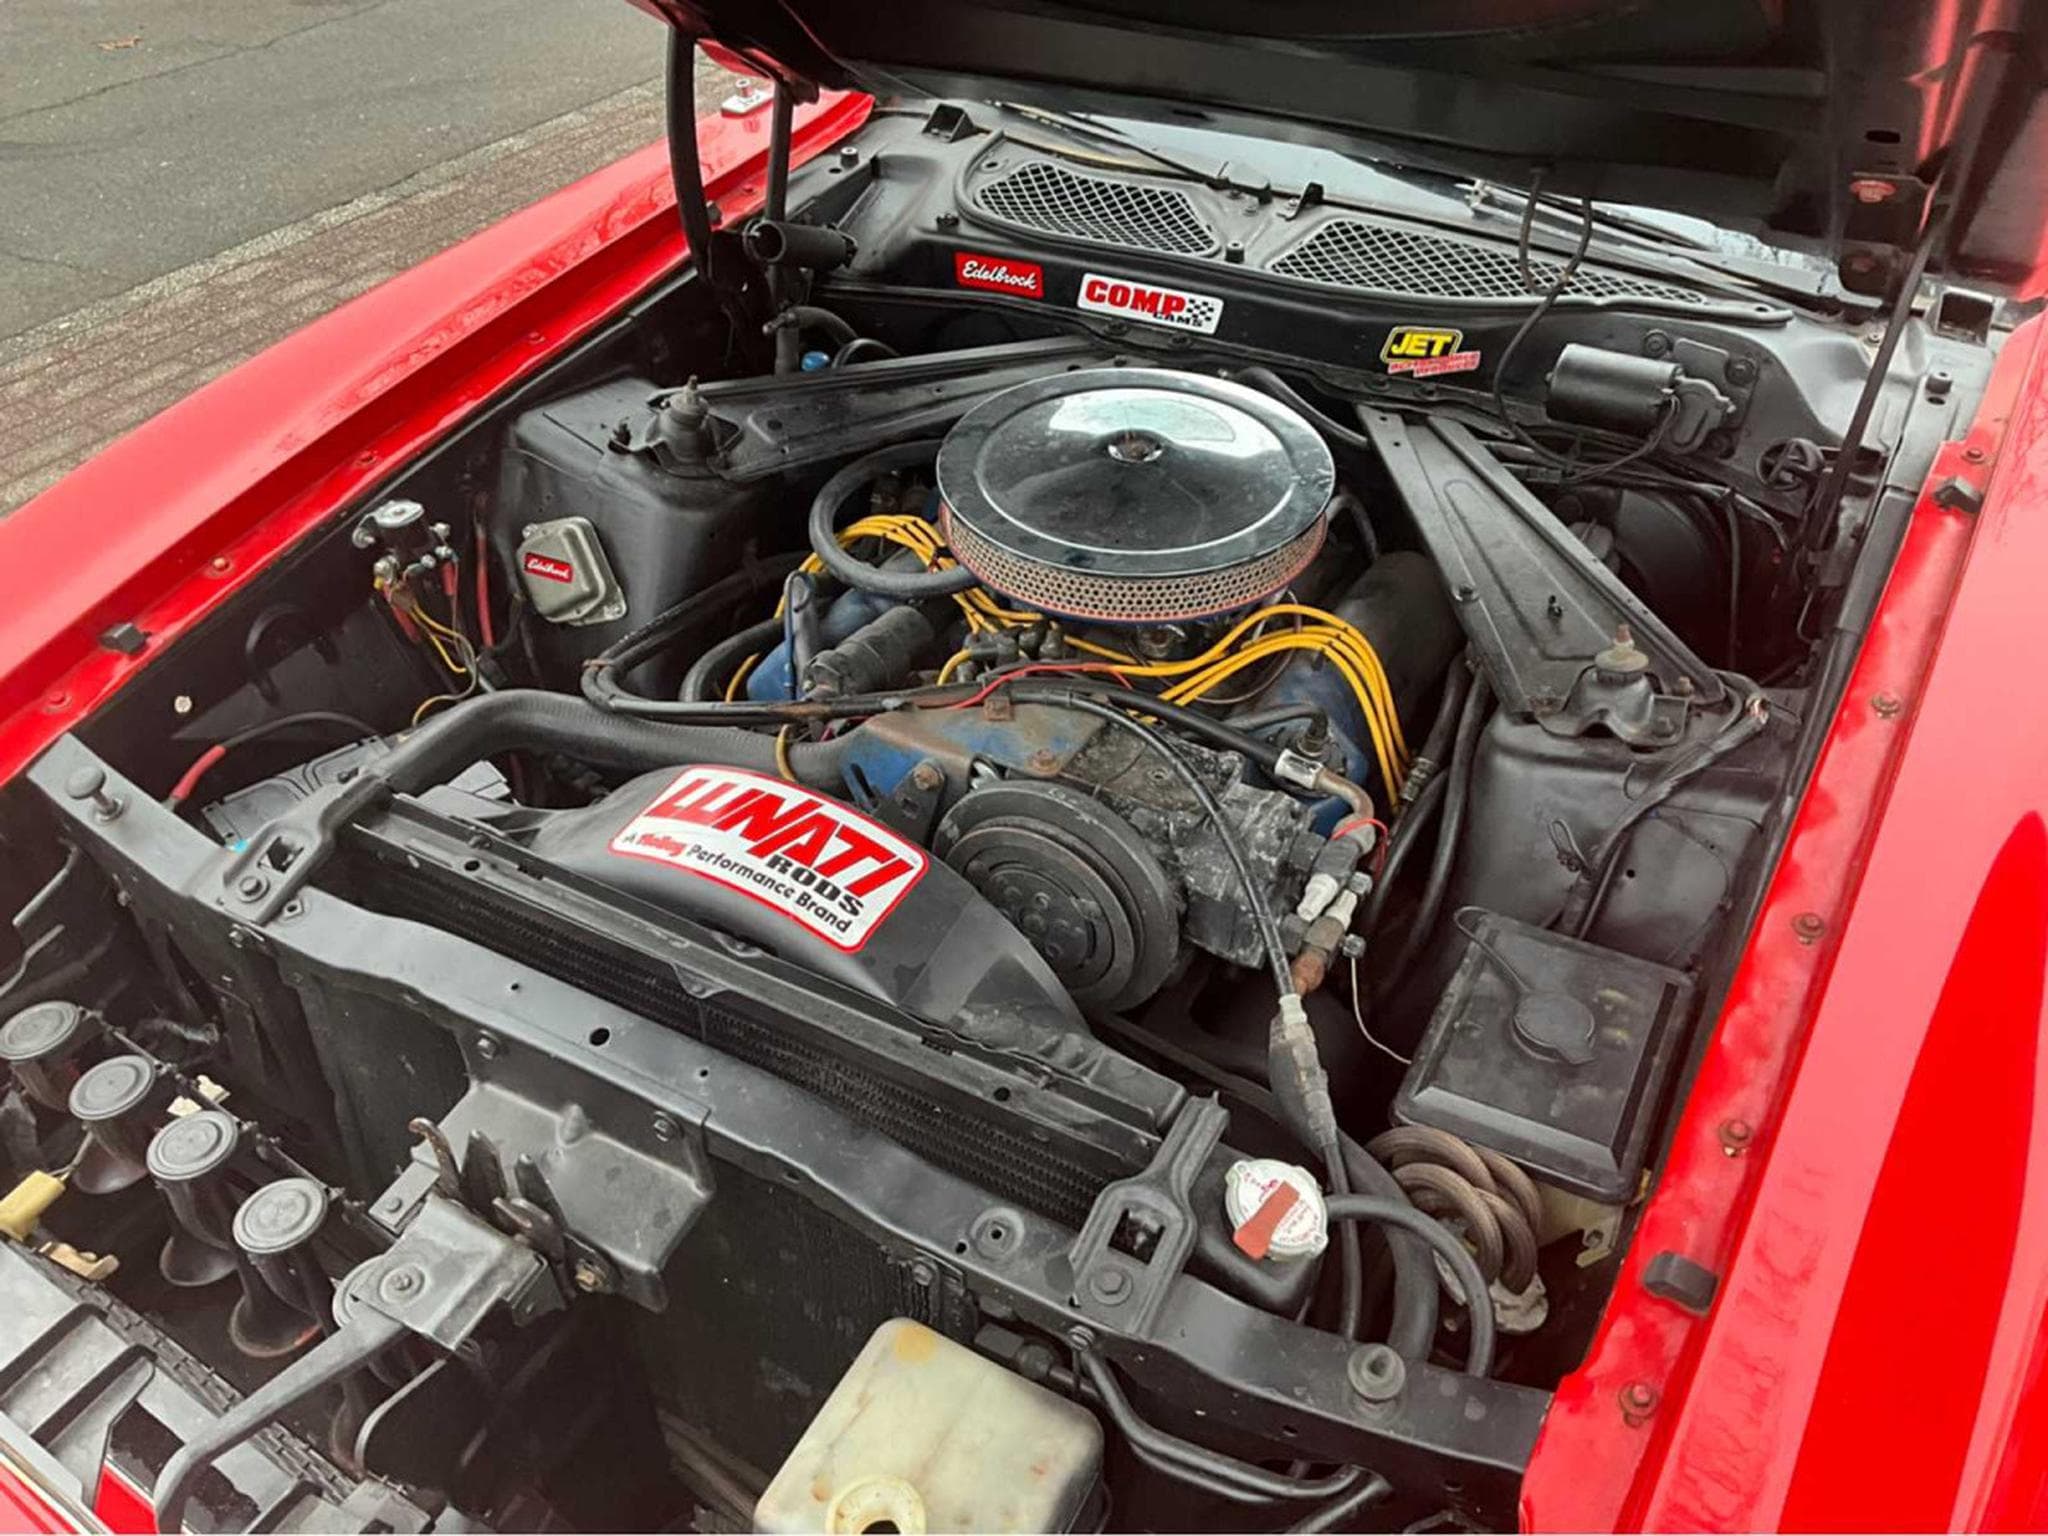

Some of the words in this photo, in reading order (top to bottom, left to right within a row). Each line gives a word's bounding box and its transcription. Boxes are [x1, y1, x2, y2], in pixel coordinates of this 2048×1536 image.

[962, 260, 1037, 290] Edelbrock
[1085, 279, 1187, 314] COMP
[1153, 312, 1203, 327] CAMS
[1391, 333, 1452, 357] JET
[643, 778, 914, 898] LUNATI
[622, 832, 637, 844] A
[686, 844, 796, 899] Performance
[795, 891, 853, 933] Brand
[765, 854, 865, 917] RODS
